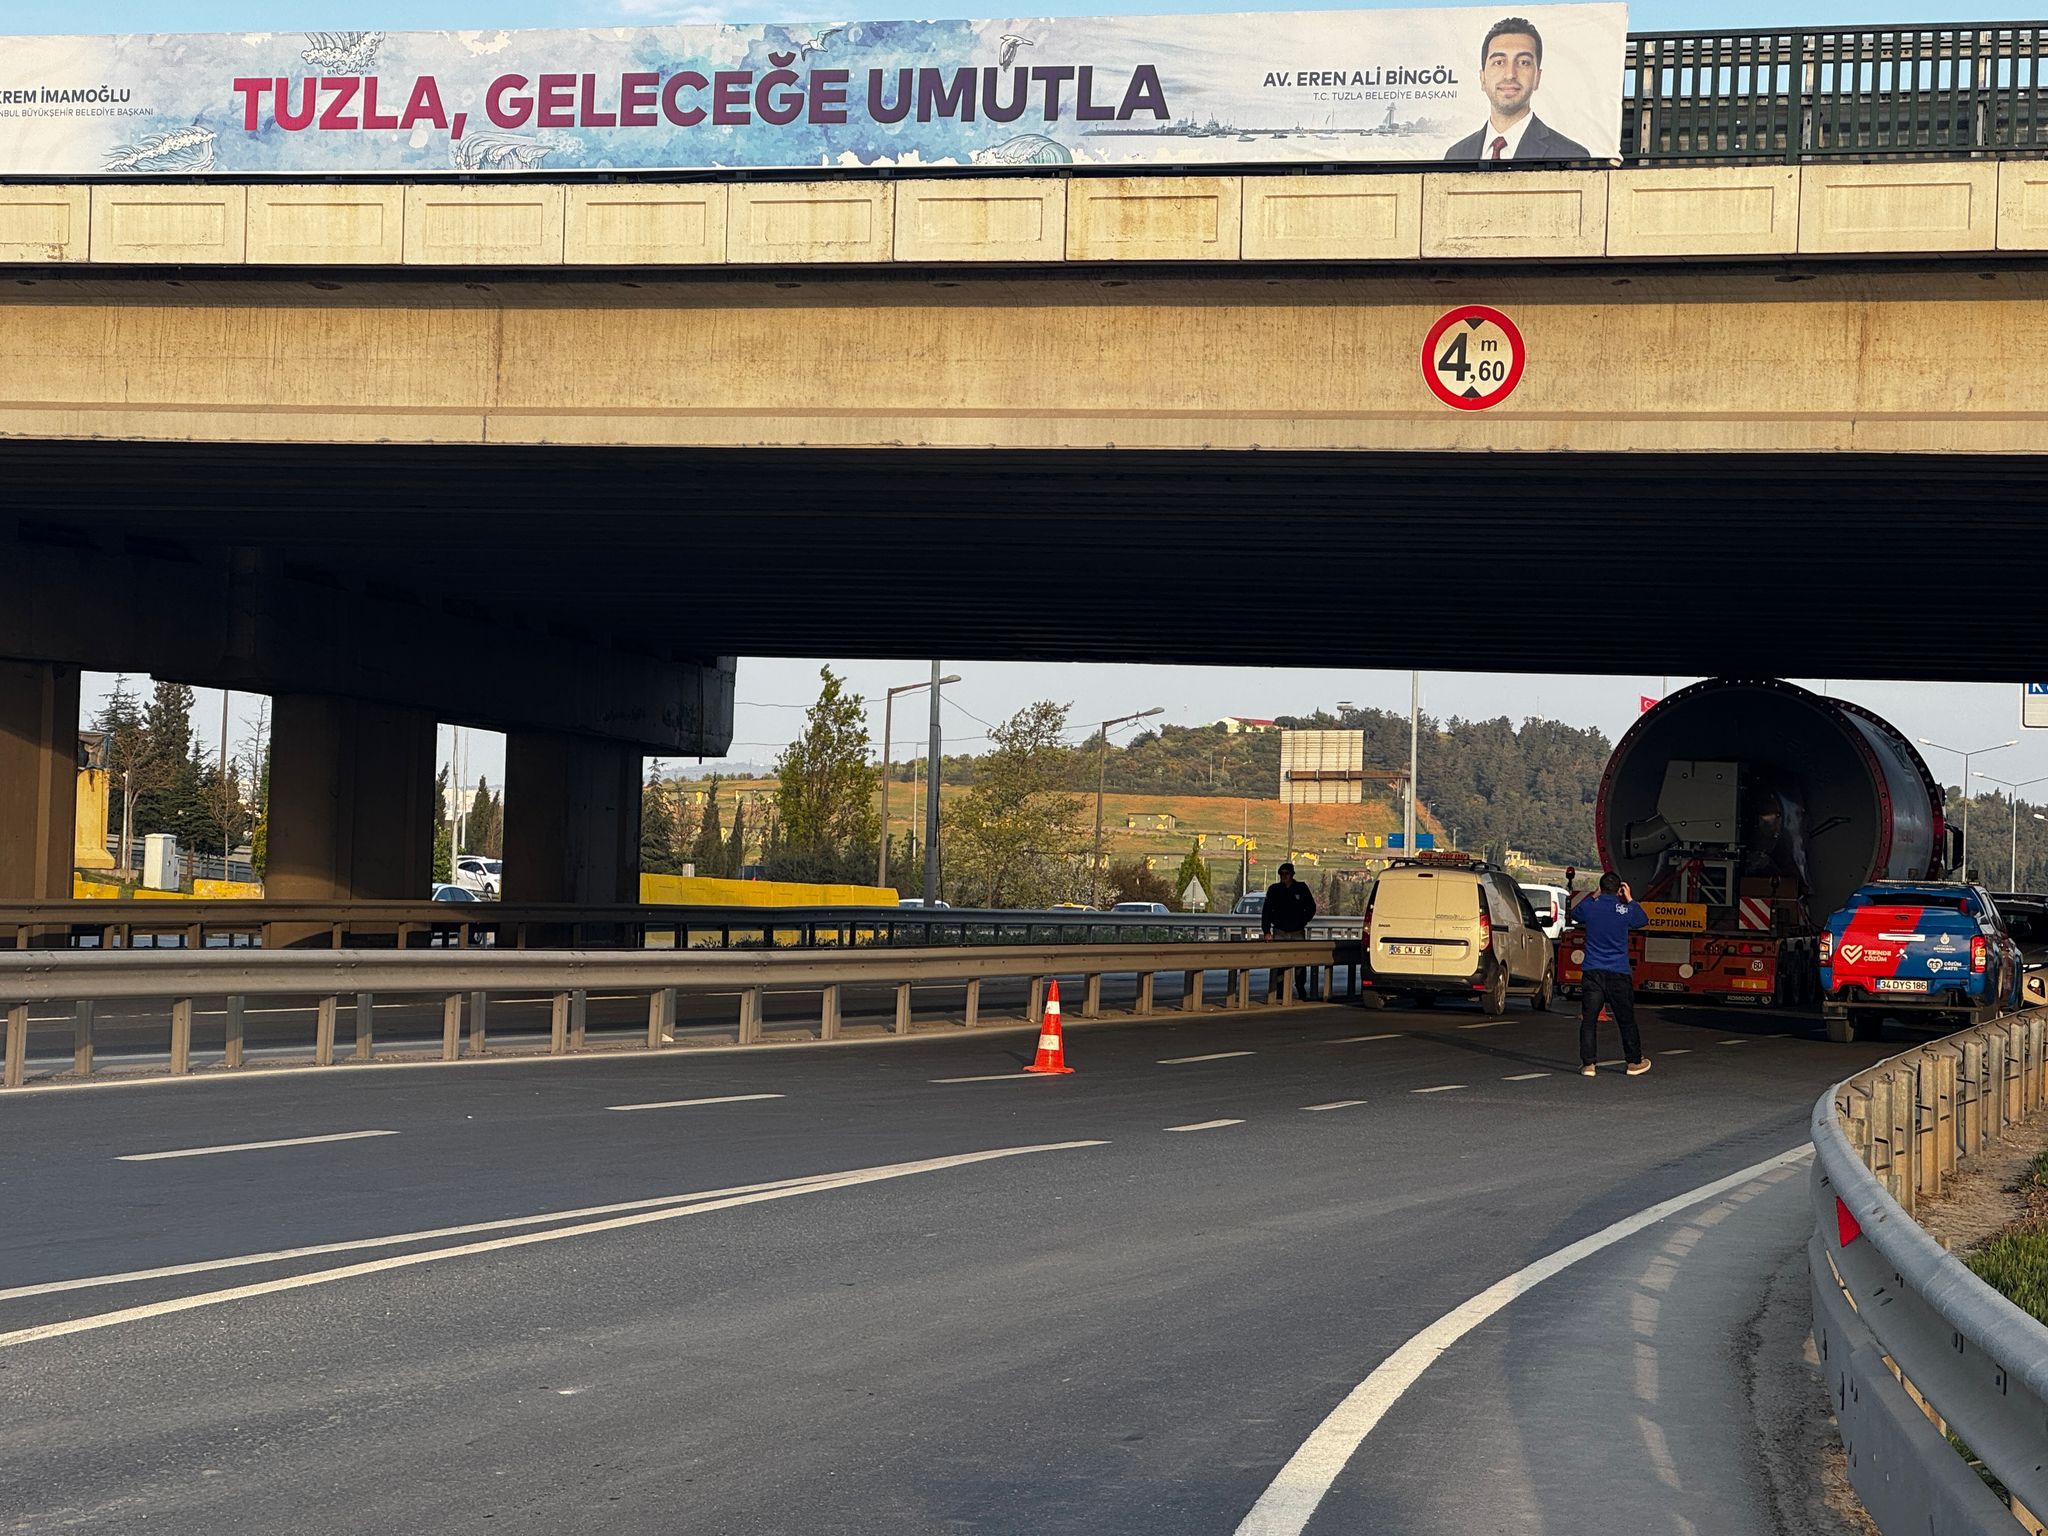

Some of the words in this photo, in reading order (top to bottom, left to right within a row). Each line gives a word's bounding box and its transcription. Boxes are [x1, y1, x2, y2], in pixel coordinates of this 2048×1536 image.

[1263, 72, 1292, 87] AV.
[1297, 71, 1347, 87] EREN
[1351, 66, 1382, 86] ALİ
[1385, 65, 1459, 85] BİNGÖL
[0, 90, 37, 104] REM
[41, 85, 131, 103] İMAMOĞLU
[233, 75, 468, 140] TUZLA,
[485, 51, 849, 129] GELECEĞE
[867, 64, 1171, 124] UMUTLA
[1313, 92, 1330, 101] T.C.
[1332, 92, 1363, 100] TUZLA
[1365, 90, 1412, 100] BELEDİYE
[1415, 90, 1458, 100] BAŞKANI
[22, 107, 74, 117] BÜYÜKŞEHİR
[75, 107, 115, 116] BELEDİYE
[117, 107, 154, 117] BAŞKANI
[1481, 340, 1498, 352] m
[1655, 906, 1687, 916] CONVOI
[1648, 918, 1703, 929] CEPTIONNEL
[1753, 961, 1762, 969] 60
[1881, 980, 1891, 989] 34
[1892, 981, 1912, 990] DYS
[1913, 981, 1927, 990] 186
